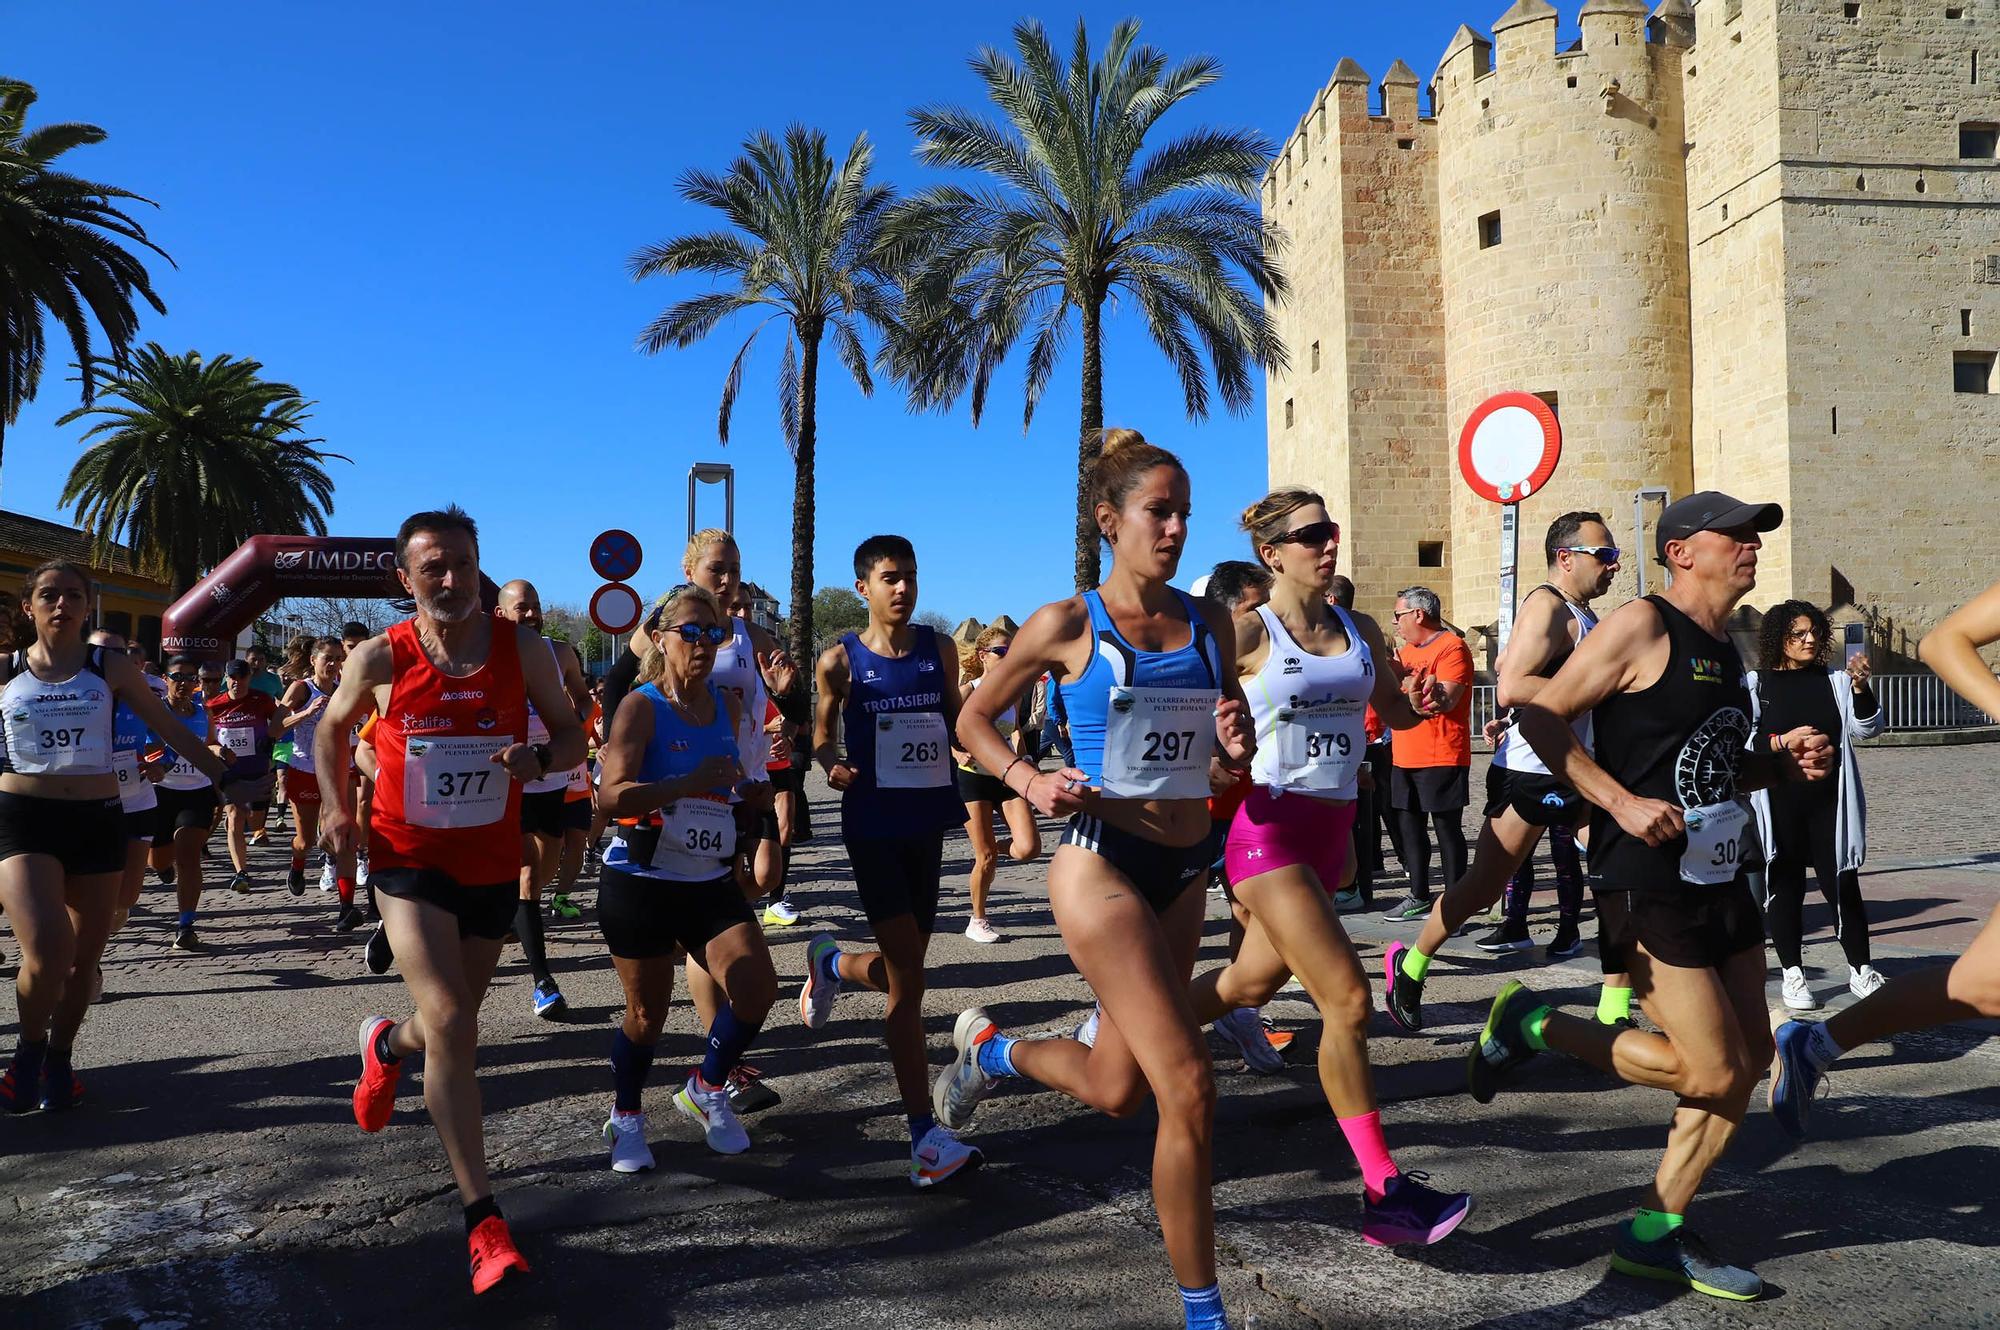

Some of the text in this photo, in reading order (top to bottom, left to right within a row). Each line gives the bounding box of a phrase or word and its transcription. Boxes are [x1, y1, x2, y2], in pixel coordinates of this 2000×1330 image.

[308, 550, 399, 571] IMDEC
[170, 637, 219, 648] IMDECO
[862, 692, 941, 713] TROTASIERRA
[1144, 696, 1156, 704] XXI
[1157, 696, 1188, 704] CARRERA
[411, 716, 453, 729] califas
[40, 727, 85, 749] 397
[229, 738, 248, 748] 335
[1141, 731, 1195, 762] 297
[1306, 732, 1351, 758] 379
[901, 742, 939, 762] 263
[173, 763, 195, 774] 311
[567, 771, 581, 782] 44
[437, 770, 491, 797] 377
[685, 828, 722, 852] 364
[1711, 838, 1740, 865] 30
